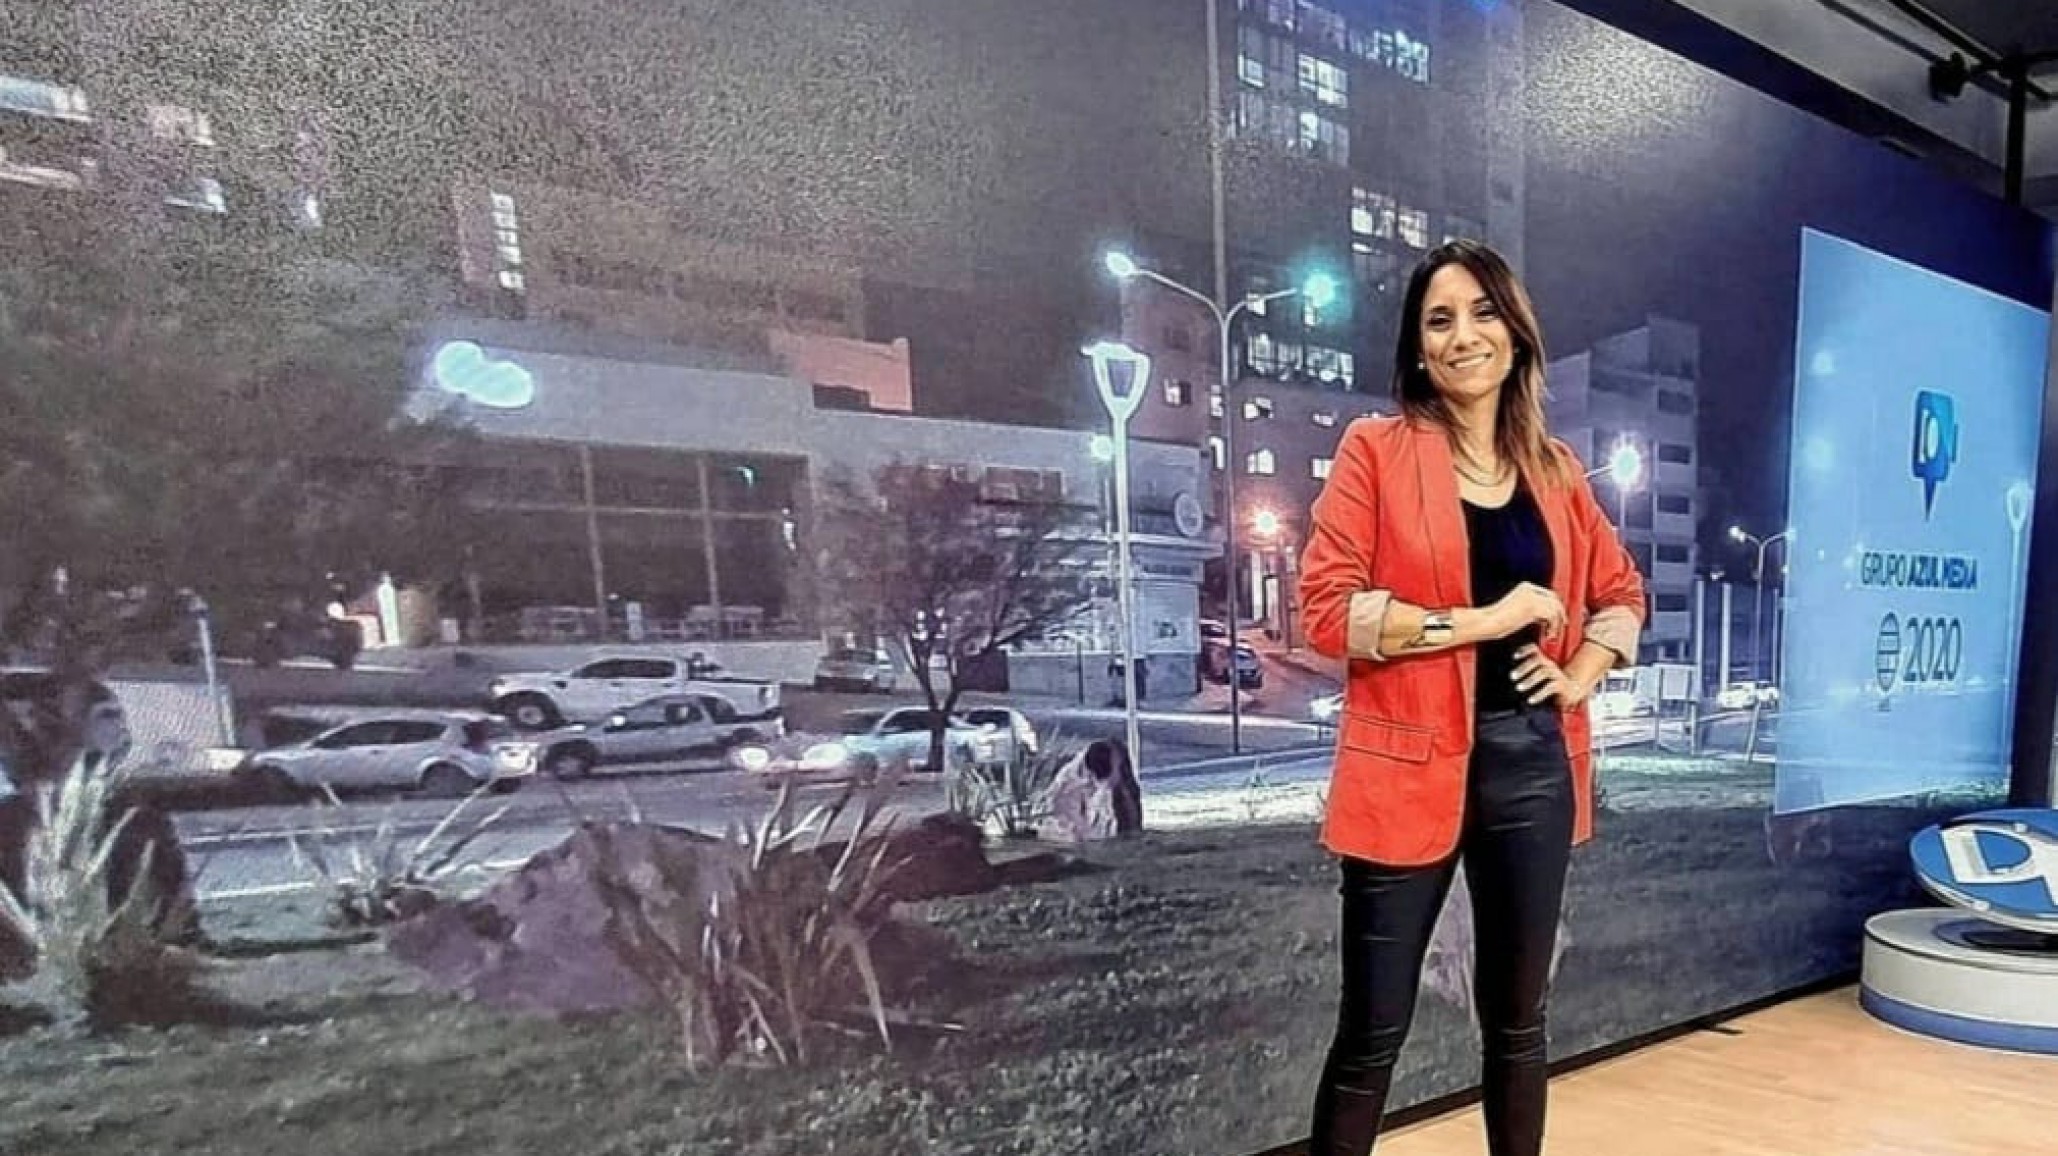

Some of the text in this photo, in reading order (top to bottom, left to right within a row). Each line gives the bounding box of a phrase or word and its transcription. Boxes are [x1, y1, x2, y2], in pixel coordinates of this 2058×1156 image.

[1862, 552, 1905, 586] GRUPO
[1907, 555, 1939, 588] AZUL
[1903, 617, 1962, 682] 2020
